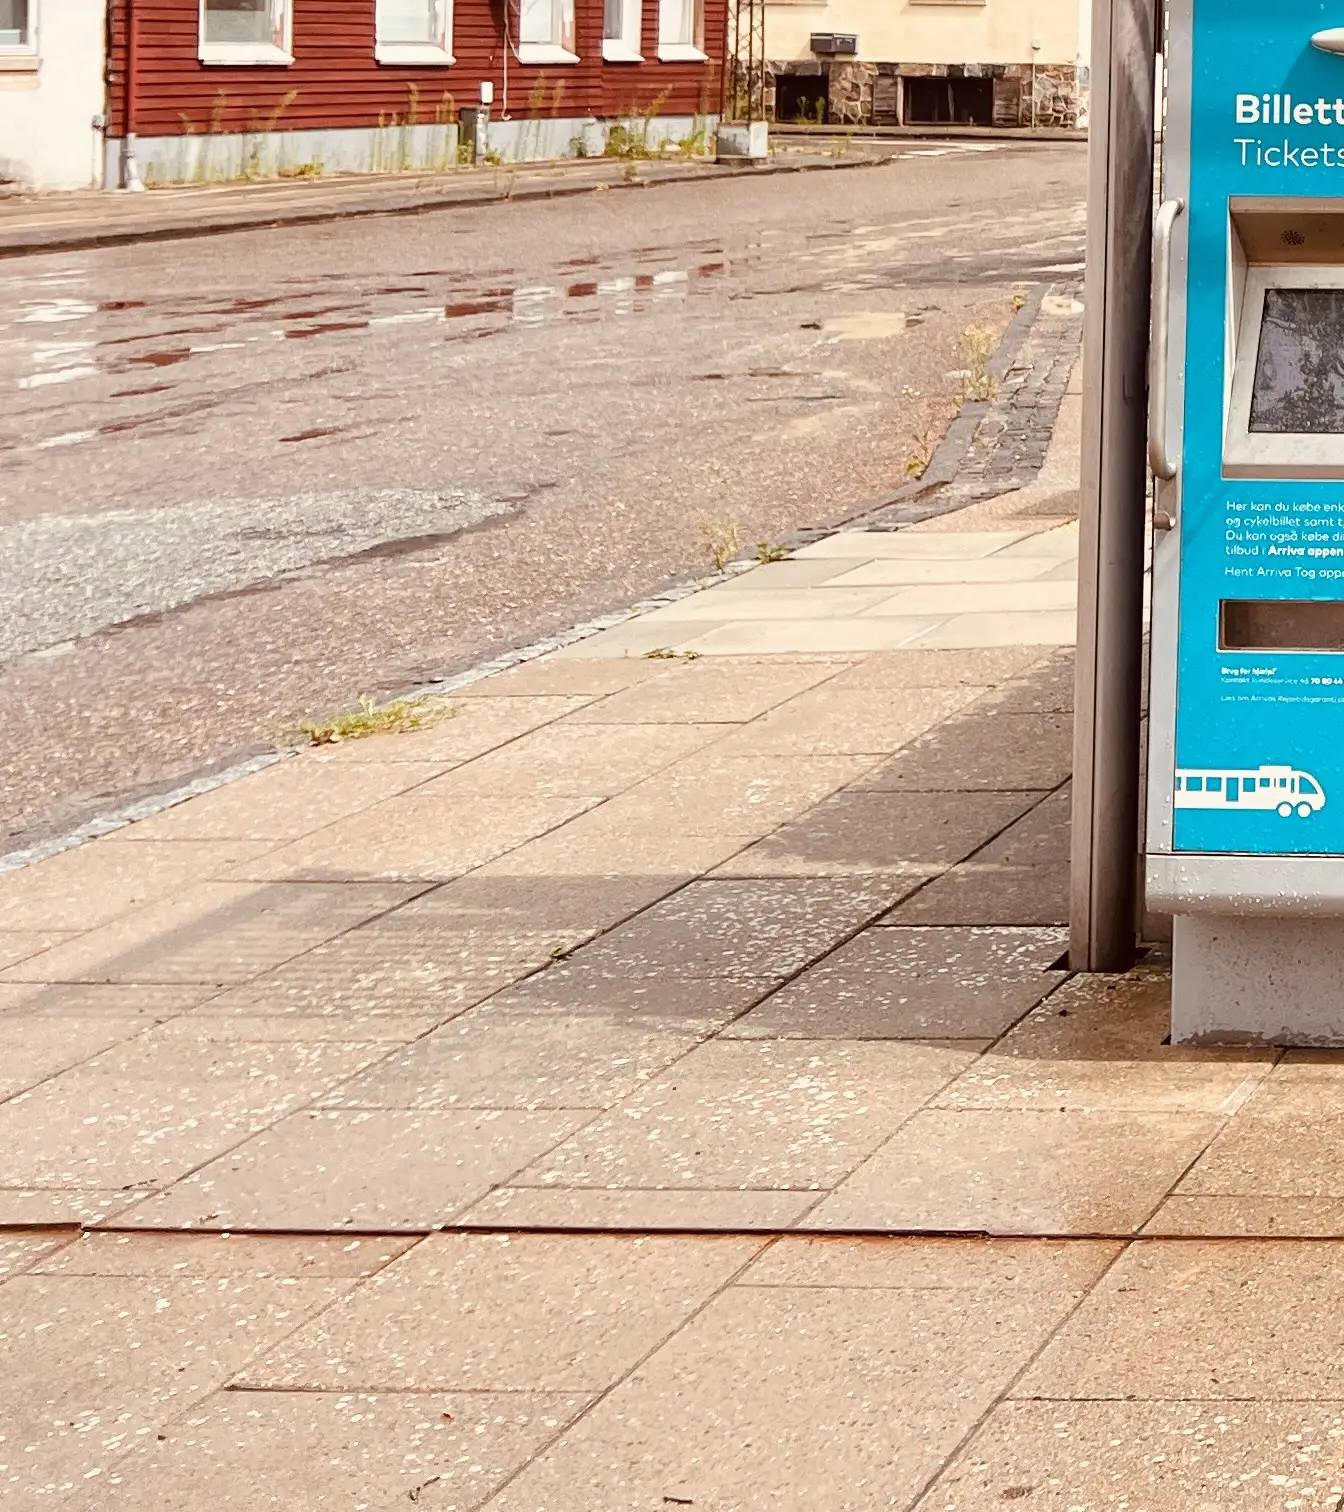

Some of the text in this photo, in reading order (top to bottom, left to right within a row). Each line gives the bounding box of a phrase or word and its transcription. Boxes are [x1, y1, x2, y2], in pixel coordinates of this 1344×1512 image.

[1227, 501, 1246, 512] Her
[1251, 502, 1272, 512] kan
[1275, 502, 1290, 512] du
[1293, 502, 1321, 513] købe
[1226, 518, 1241, 528] og
[1304, 517, 1334, 528] samt
[1226, 531, 1242, 542] Du
[1246, 531, 1266, 542] kan
[1270, 530, 1298, 544] også
[1301, 532, 1330, 542] købe
[1226, 546, 1258, 556] tilbud
[1268, 546, 1305, 557] Arriva
[1308, 548, 1344, 559] appen
[1225, 566, 1253, 577] Hent
[1257, 566, 1292, 578] Arriva
[1295, 566, 1316, 579] Tog
